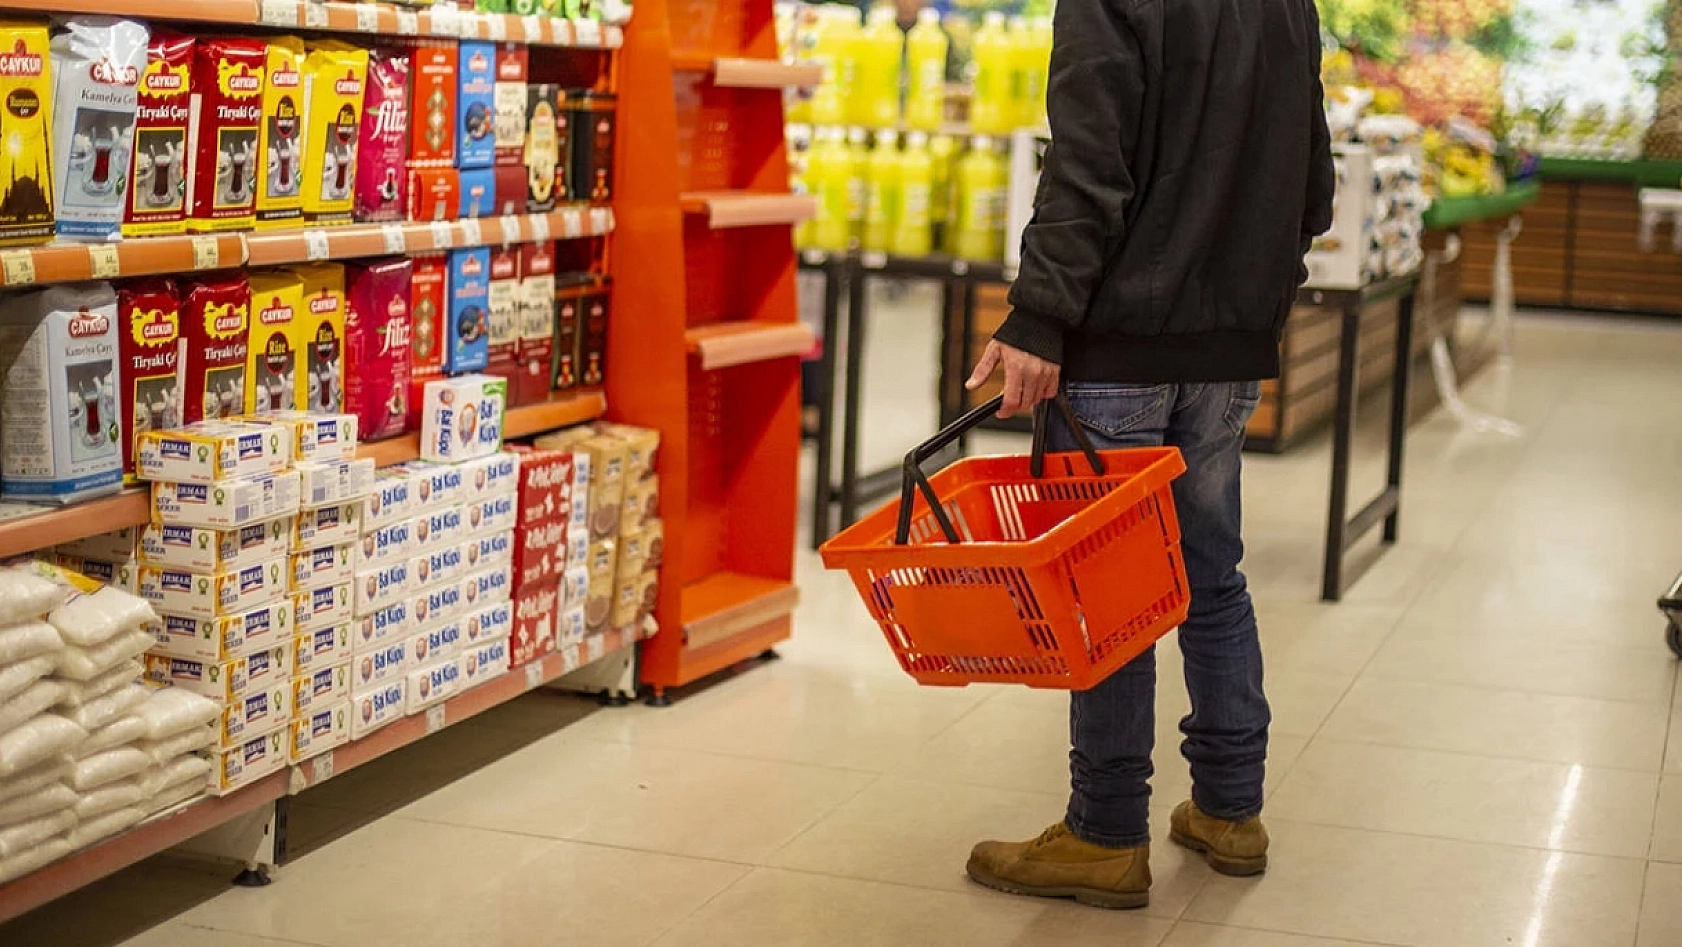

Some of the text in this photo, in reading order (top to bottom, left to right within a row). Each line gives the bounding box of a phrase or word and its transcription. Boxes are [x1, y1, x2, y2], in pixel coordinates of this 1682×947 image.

[0, 57, 42, 73] ÇAYKUR
[94, 62, 137, 82] ÇAKUR
[162, 441, 191, 454] IRMAK
[177, 485, 207, 495] IRMAK
[432, 474, 443, 493] Bal
[382, 487, 393, 507] Bal
[431, 515, 442, 533] Bal
[163, 529, 191, 539] IRMAK
[377, 529, 388, 548] Bal
[431, 553, 442, 572] Bal
[162, 574, 191, 586] IRMAK
[379, 569, 389, 589] Bal
[430, 592, 440, 610] Bal
[168, 618, 195, 628] IRMAK
[375, 611, 386, 629] Bal
[430, 631, 440, 649] Bal
[375, 650, 385, 670] Bal
[431, 668, 442, 687] Bal
[374, 693, 385, 712] Bal
